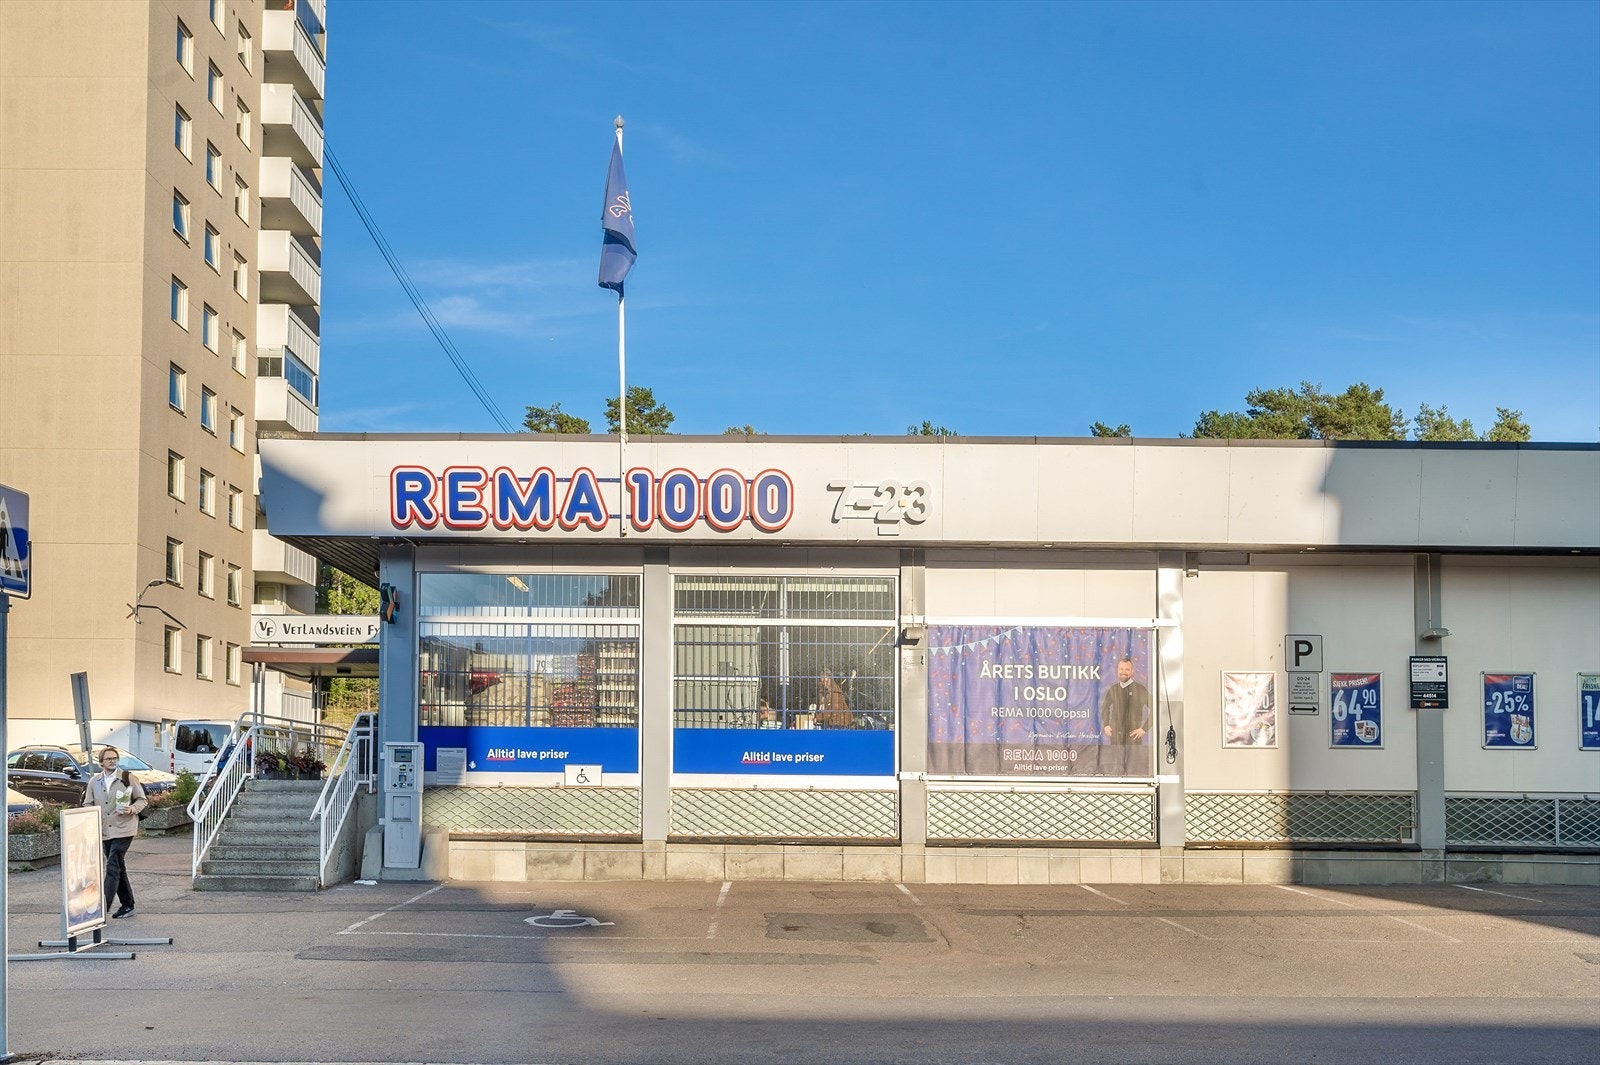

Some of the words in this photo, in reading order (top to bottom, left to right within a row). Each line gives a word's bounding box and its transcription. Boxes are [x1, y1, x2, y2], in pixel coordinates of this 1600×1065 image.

[390, 466, 609, 531] REMA
[627, 466, 794, 531] 1000
[827, 480, 932, 524] 7-23
[1295, 640, 1313, 667] P
[980, 660, 1034, 679] ÅRETS
[1038, 665, 1101, 680] BUTIKK
[1014, 686, 1018, 700] I
[1023, 686, 1067, 701] OSLO
[1486, 691, 1529, 714] -25%
[991, 707, 1024, 718] REMA
[1026, 707, 1052, 718] 1000
[1054, 708, 1090, 720] Oppsal
[487, 748, 515, 759] Alltid
[517, 749, 537, 759] lave
[540, 749, 569, 760] priser
[742, 751, 770, 761] Alltid
[772, 752, 793, 762] lave
[795, 752, 825, 763] priser
[1003, 749, 1043, 761] REMA
[1046, 749, 1077, 761] 1000
[1014, 763, 1032, 771] Alltid
[1033, 763, 1047, 771] lave
[1048, 764, 1068, 772] priser
